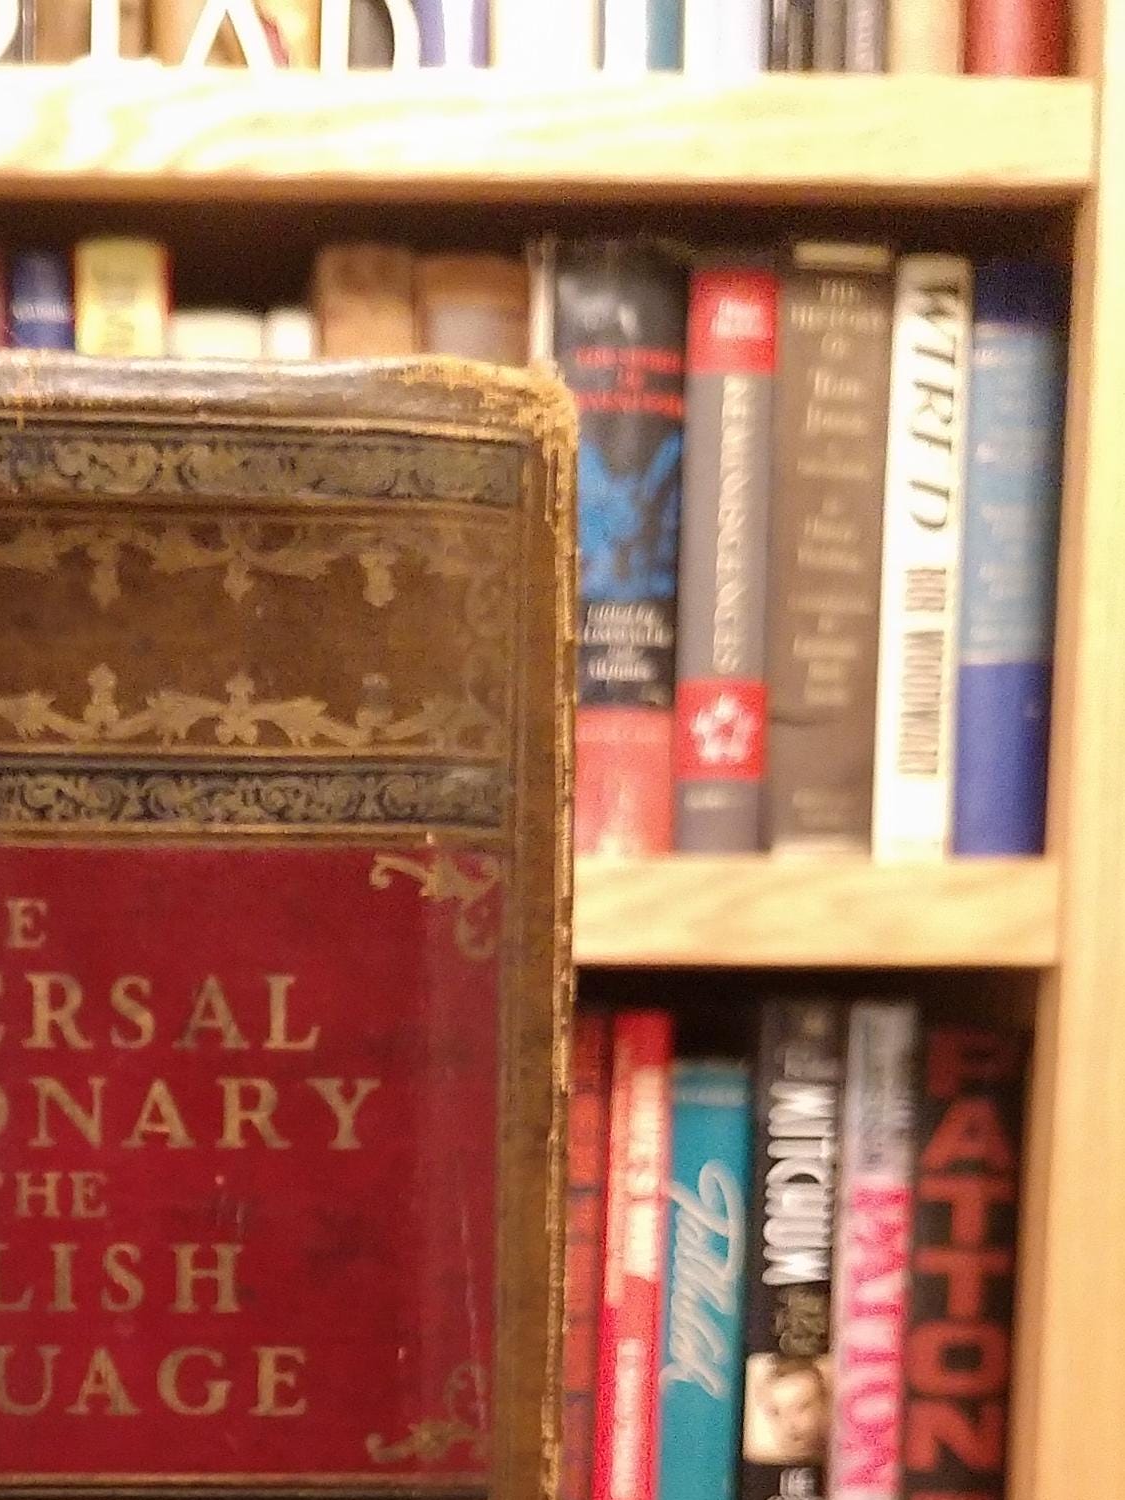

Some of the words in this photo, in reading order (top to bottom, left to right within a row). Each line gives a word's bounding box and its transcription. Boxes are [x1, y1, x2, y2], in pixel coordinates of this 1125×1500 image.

[762, 1081, 836, 1286] MITCHUM
[905, 1028, 1021, 1471] PATTON
[841, 1185, 912, 1489] PATTON
